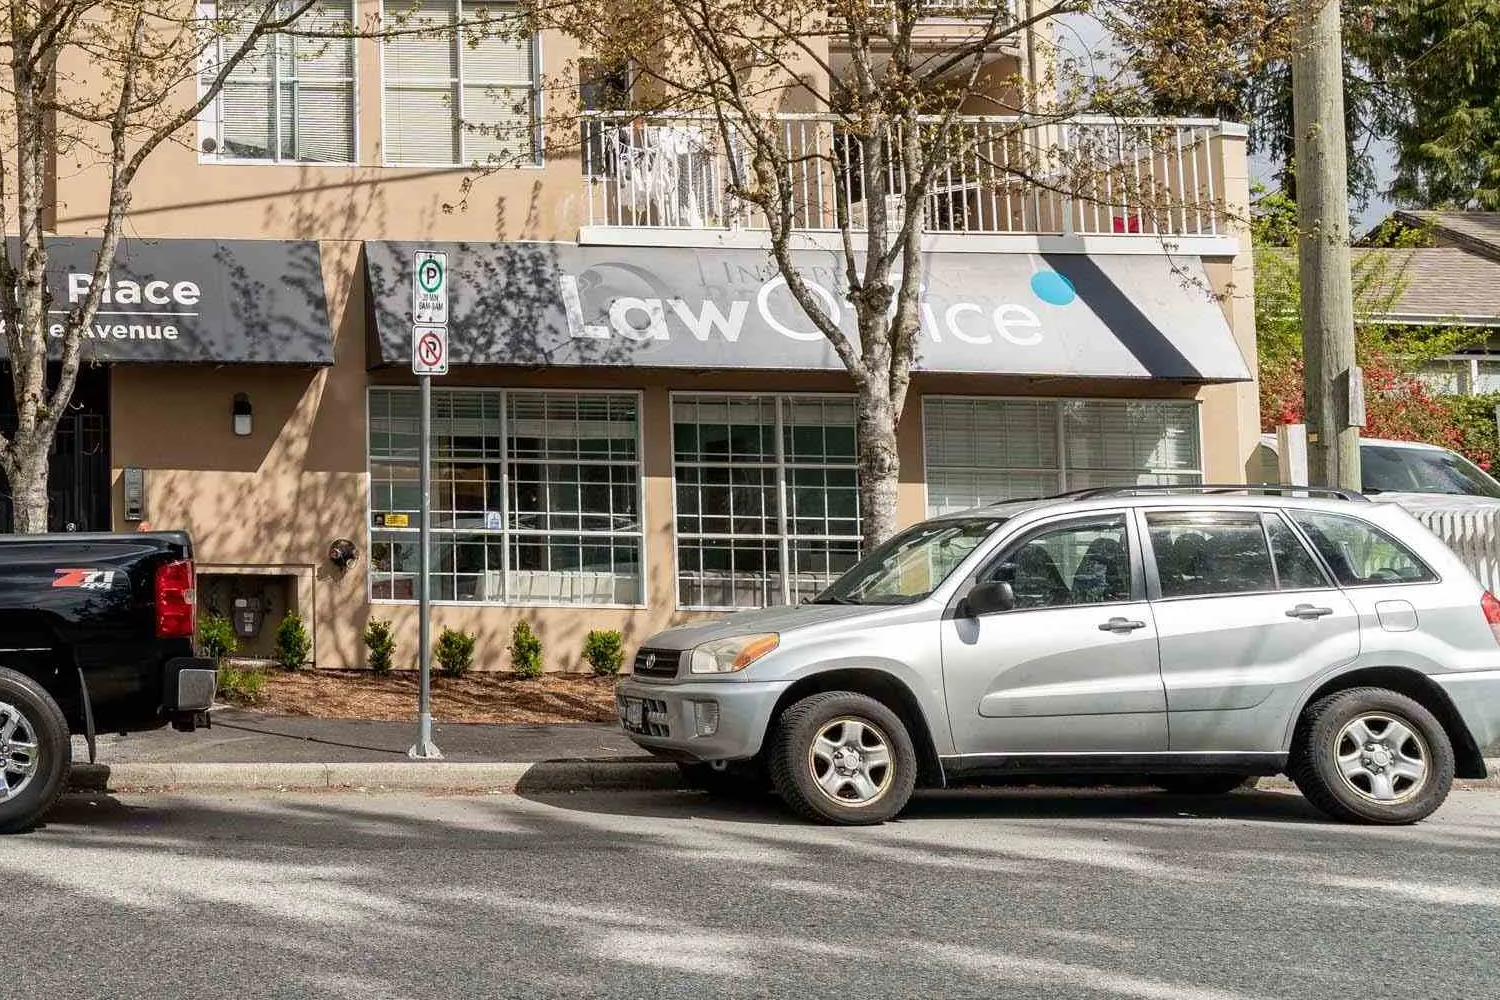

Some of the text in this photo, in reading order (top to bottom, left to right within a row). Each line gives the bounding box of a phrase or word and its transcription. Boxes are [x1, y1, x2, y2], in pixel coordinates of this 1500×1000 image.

[68, 272, 201, 305] Place
[427, 267, 437, 284] P
[757, 272, 1044, 346] Oice
[52, 568, 115, 587] Z71
